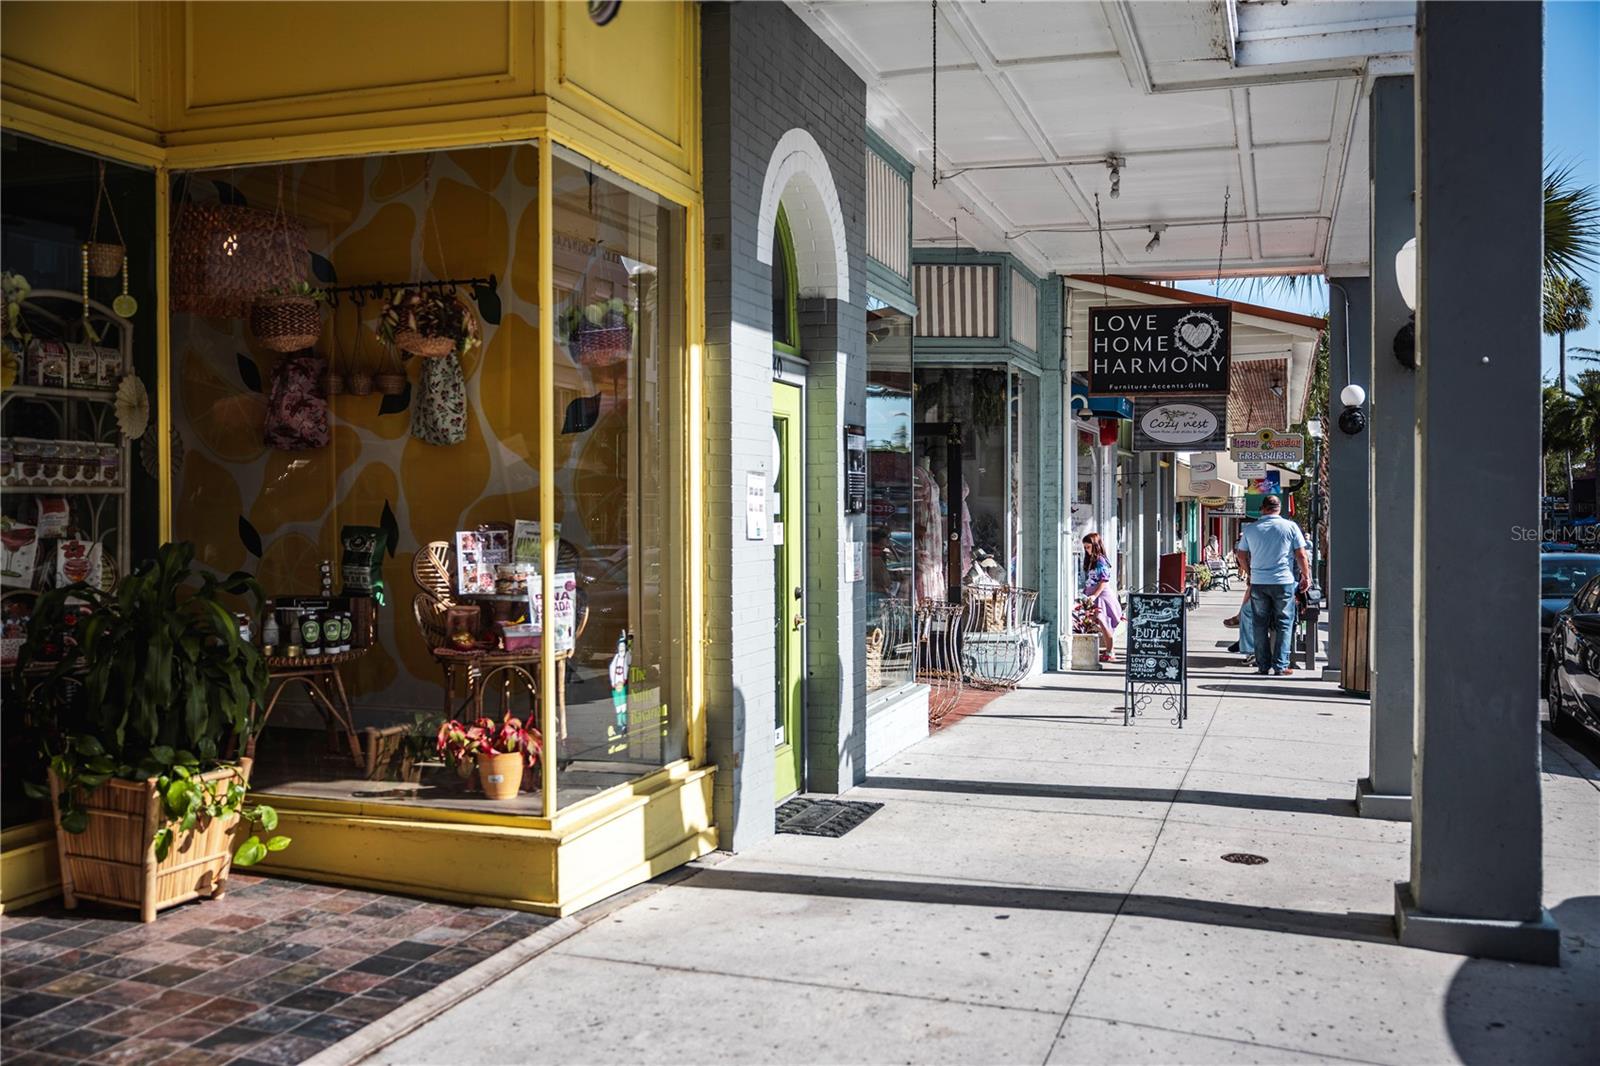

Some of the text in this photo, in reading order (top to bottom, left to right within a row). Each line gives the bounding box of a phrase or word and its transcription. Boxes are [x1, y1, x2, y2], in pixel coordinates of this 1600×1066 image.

[1094, 314, 1157, 332] LOVE
[1094, 335, 1169, 353] HOME
[1094, 356, 1225, 374] HARMONY
[1150, 418, 1178, 430] Cozy
[1136, 628, 1180, 639] BUY LOCAL
